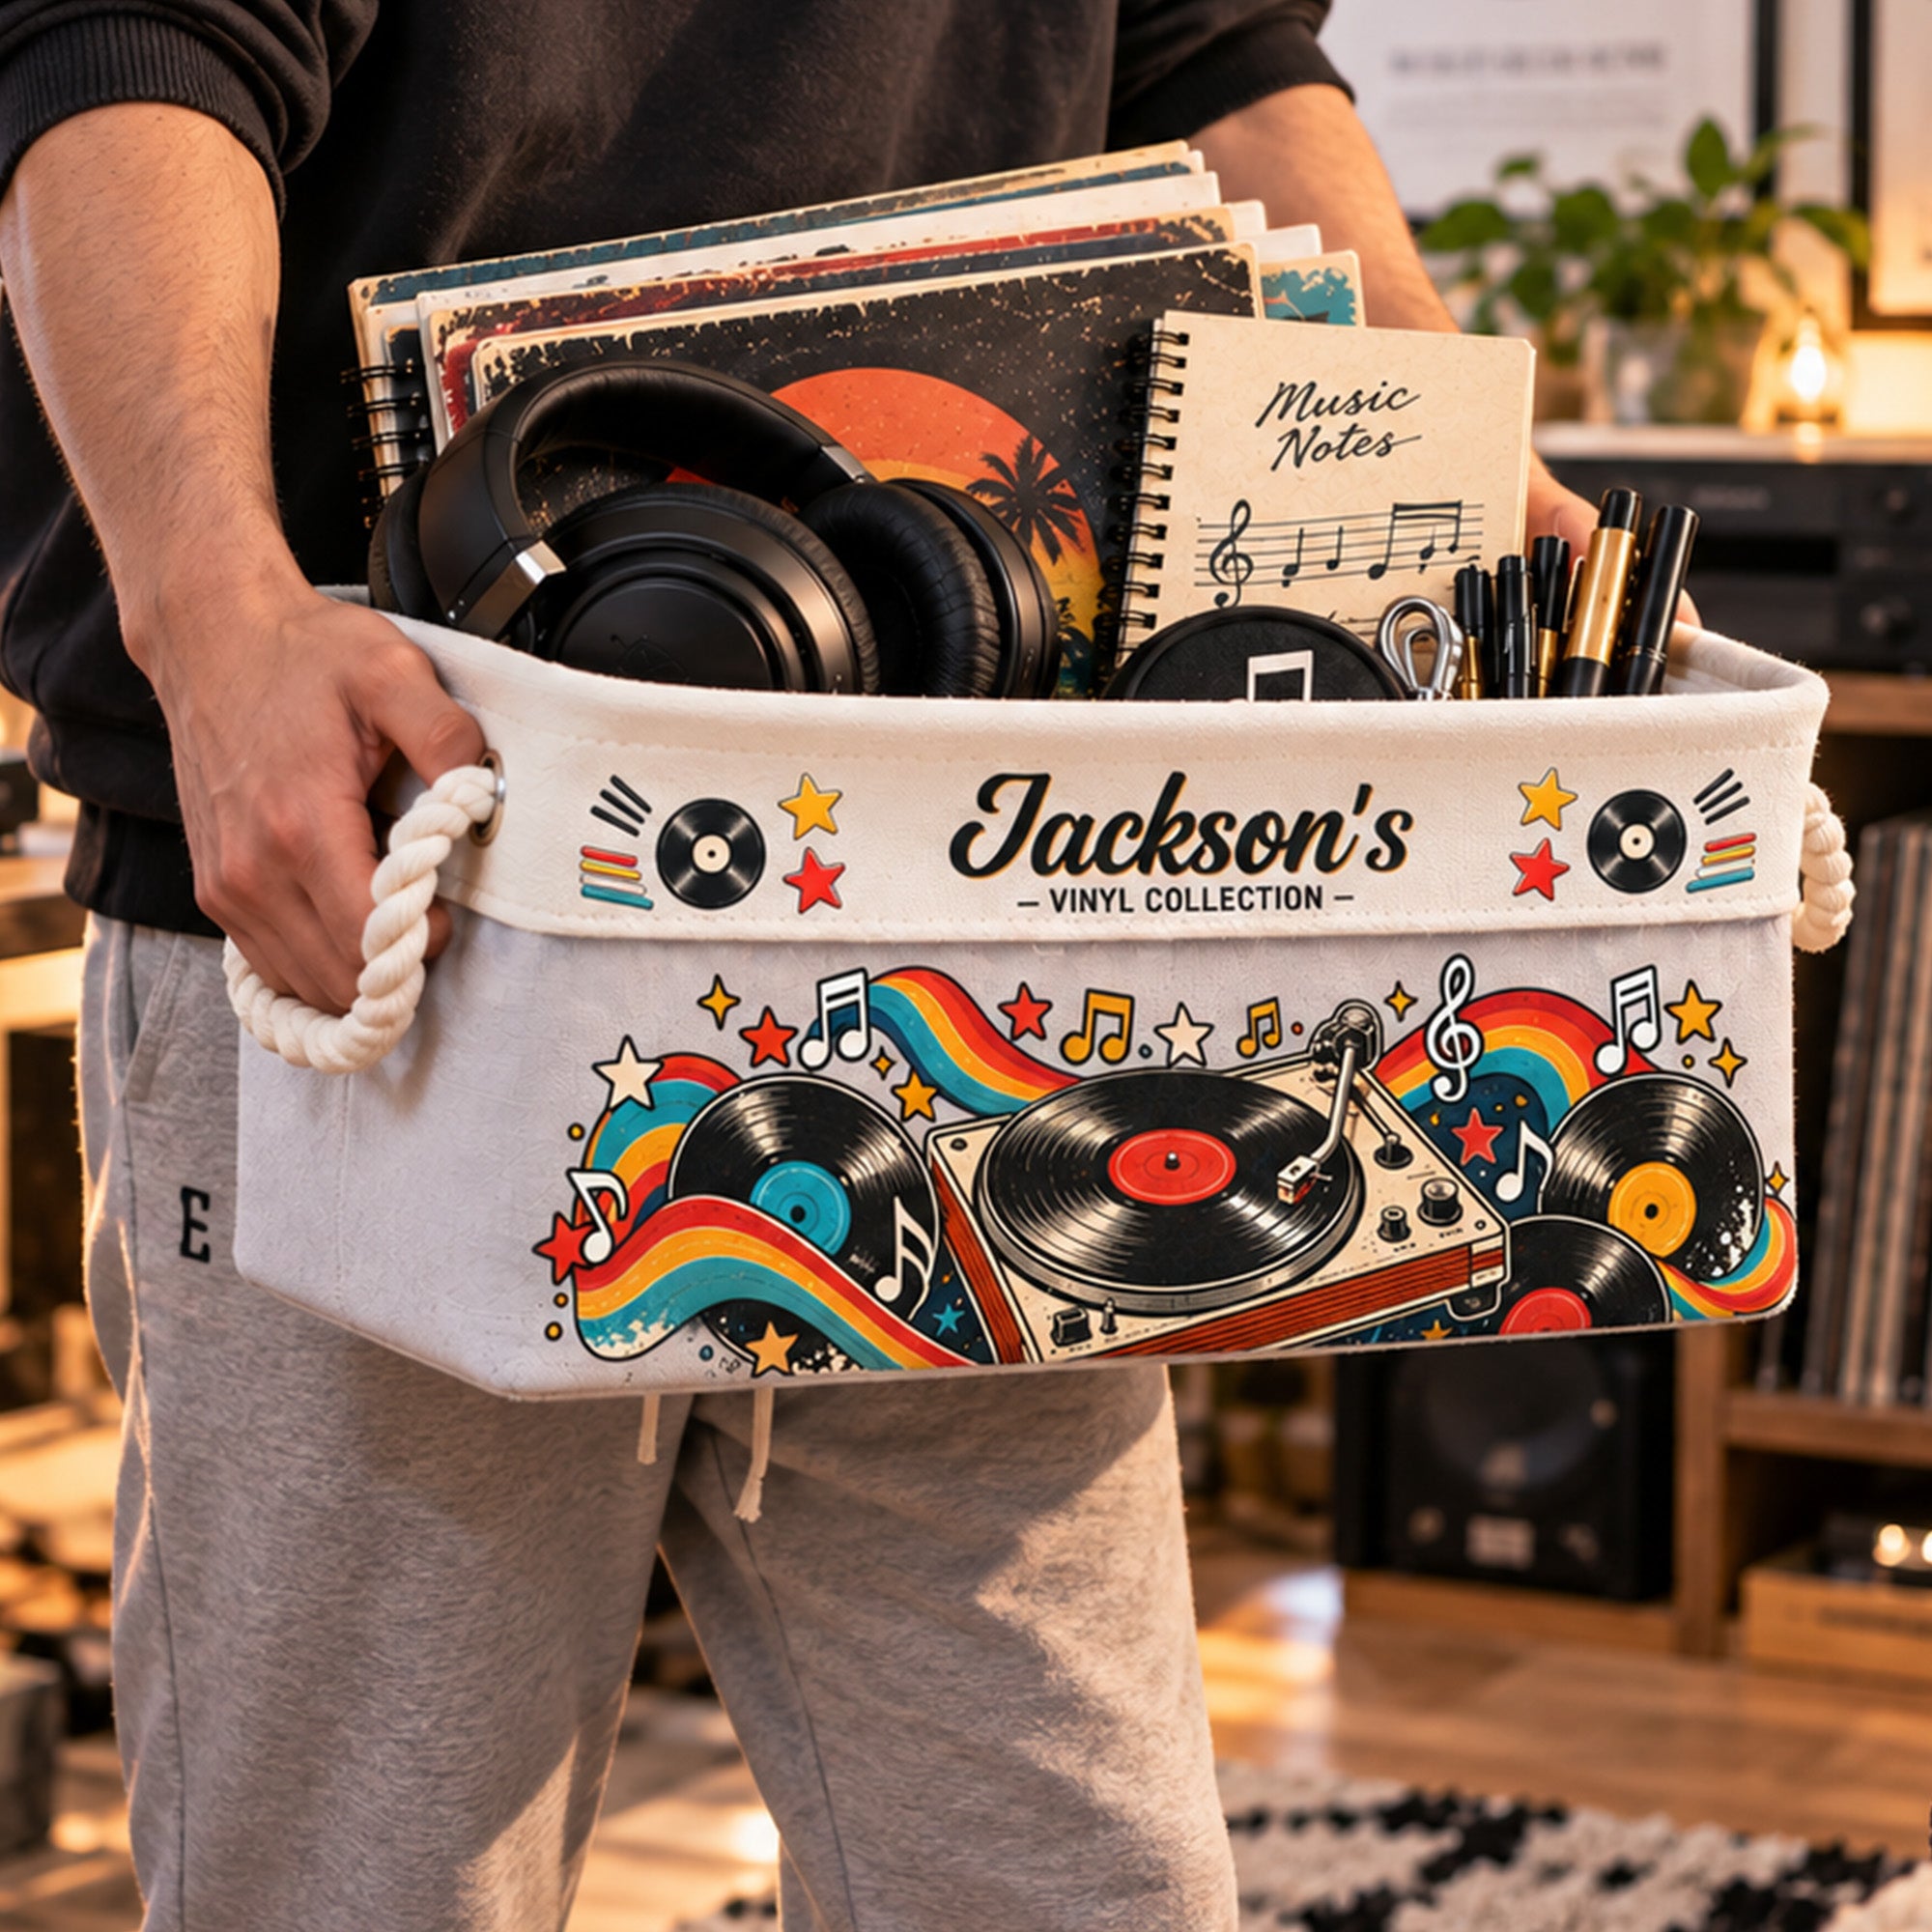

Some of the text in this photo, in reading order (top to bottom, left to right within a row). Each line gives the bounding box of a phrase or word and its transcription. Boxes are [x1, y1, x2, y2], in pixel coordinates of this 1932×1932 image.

[1255, 381, 1421, 428] Music
[1270, 422, 1422, 471] Notes
[949, 771, 1414, 879] Jackson's
[1049, 885, 1323, 914] VINYL COLLECTION
[180, 1185, 211, 1264] E
